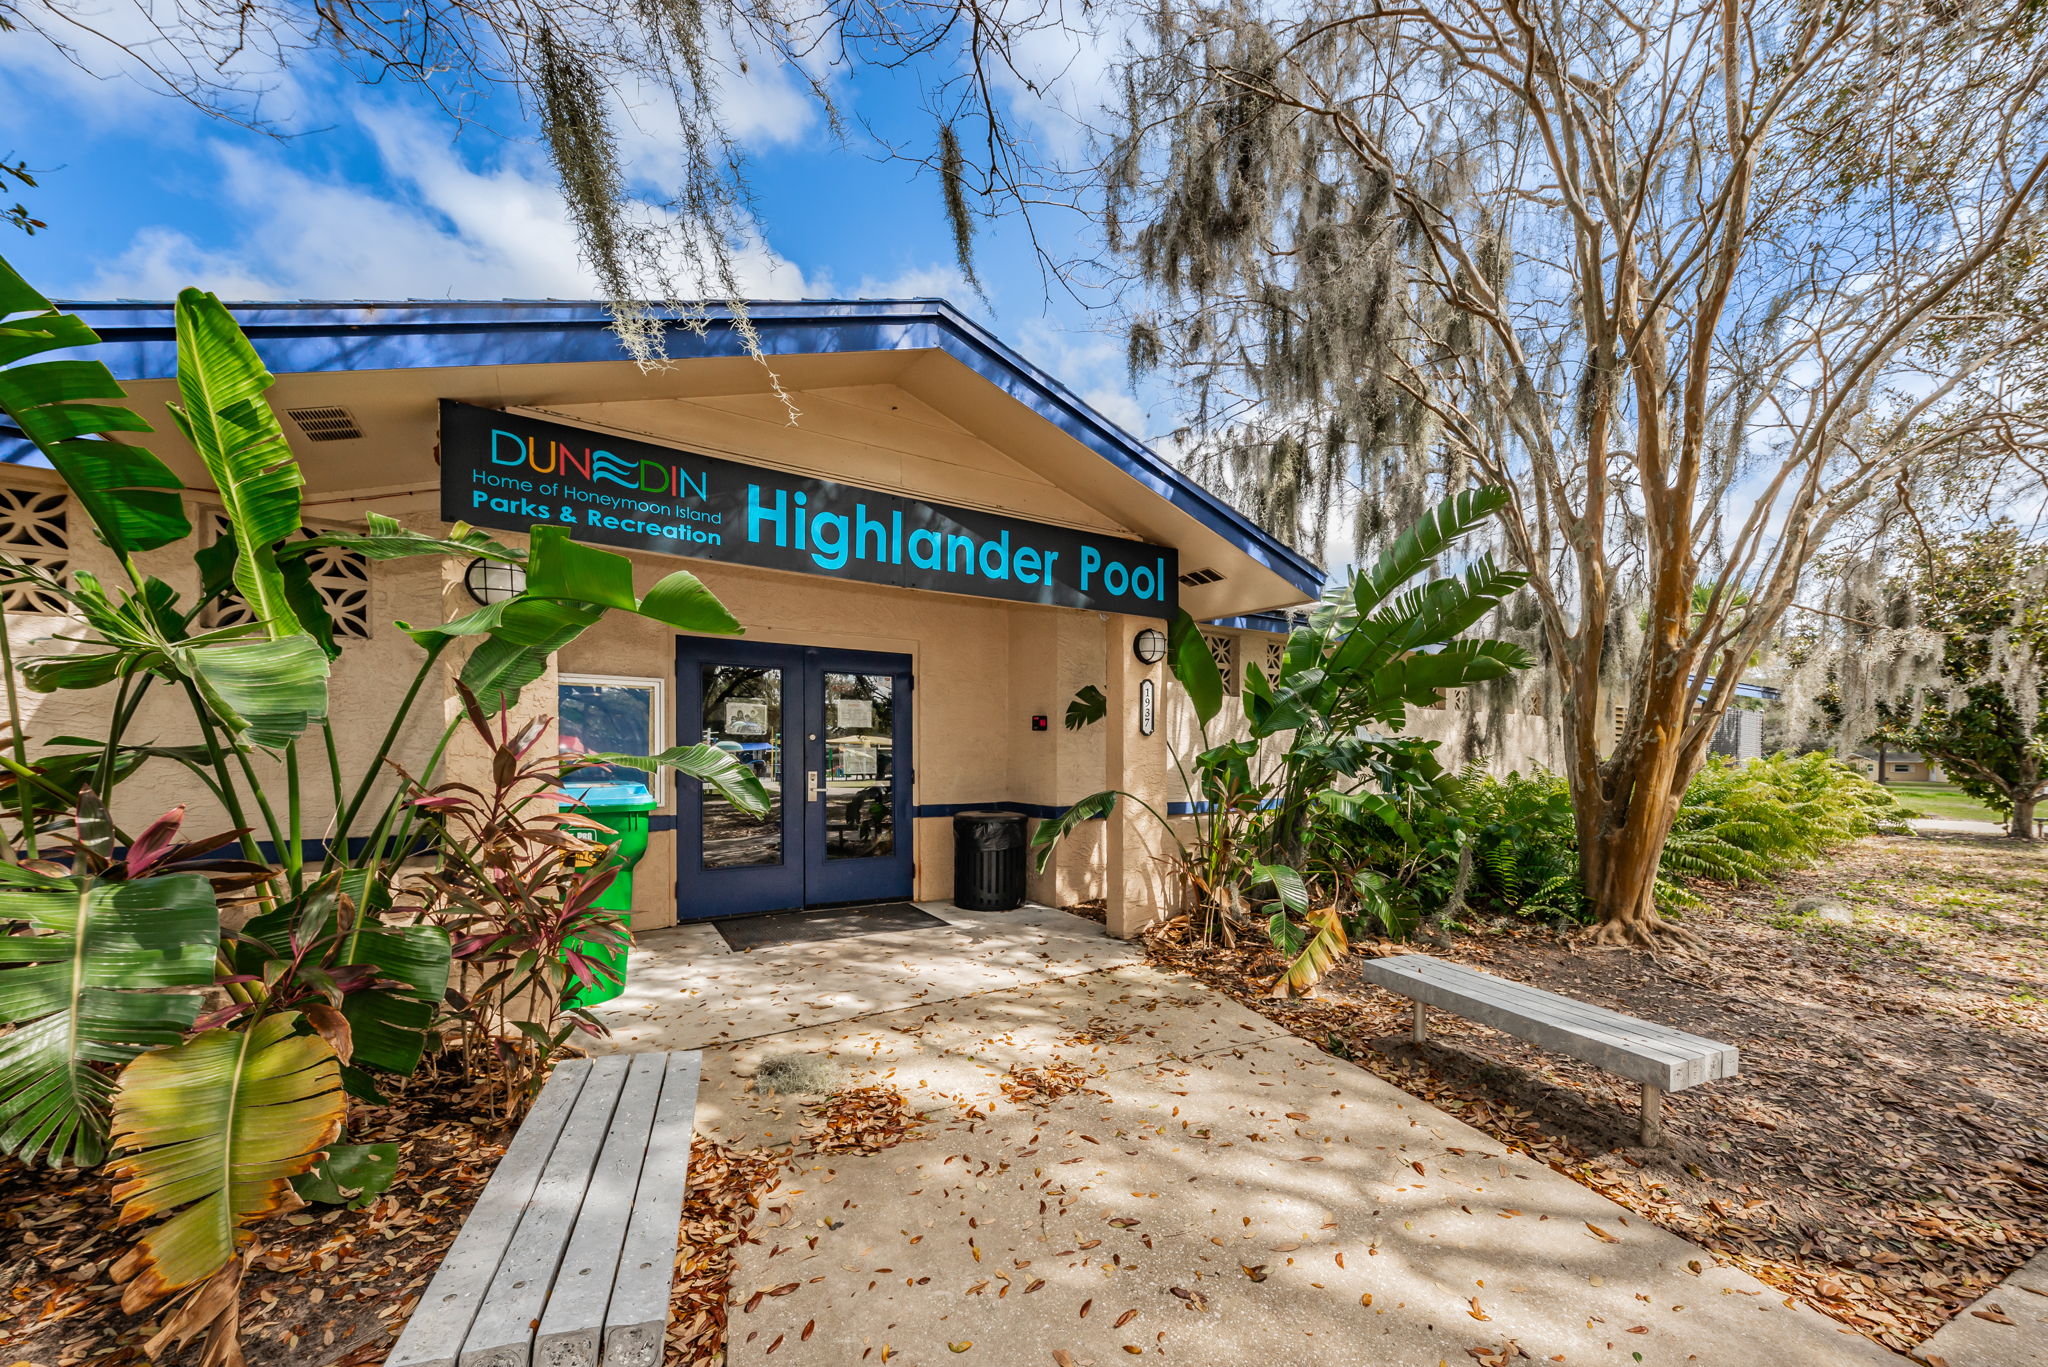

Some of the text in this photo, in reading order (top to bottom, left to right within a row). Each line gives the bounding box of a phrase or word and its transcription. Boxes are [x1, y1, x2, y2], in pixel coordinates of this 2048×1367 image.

[472, 469, 722, 525] Home of Honeymoon Island
[491, 429, 707, 502] DUNEDIN
[472, 490, 721, 546] Parks & Recreation
[747, 484, 1165, 602] Highlander Pool
